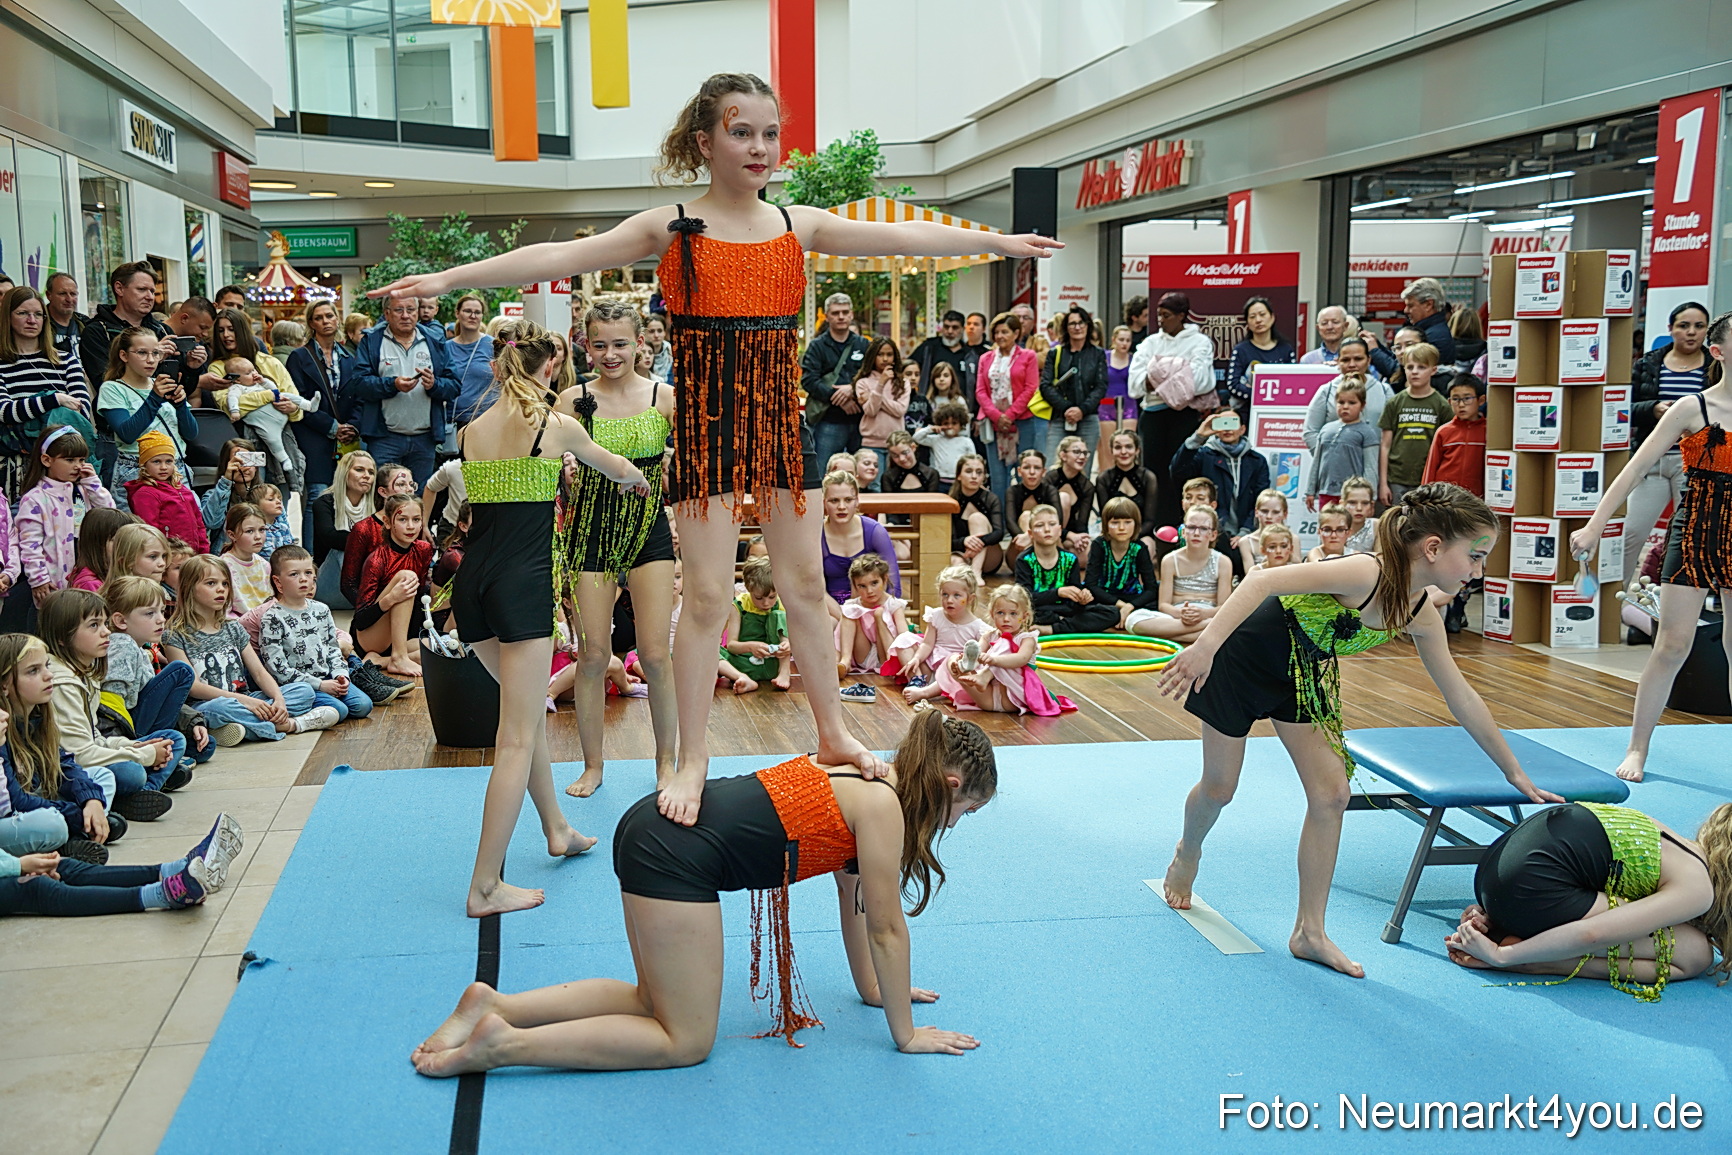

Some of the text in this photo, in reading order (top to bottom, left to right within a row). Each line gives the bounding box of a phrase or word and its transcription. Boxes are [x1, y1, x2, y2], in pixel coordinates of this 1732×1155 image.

[1673, 107, 1705, 204] 1
[1663, 211, 1701, 231] Stunde
[289, 238, 347, 248] LEBENSRAUM
[1298, 521, 1318, 535] 26
